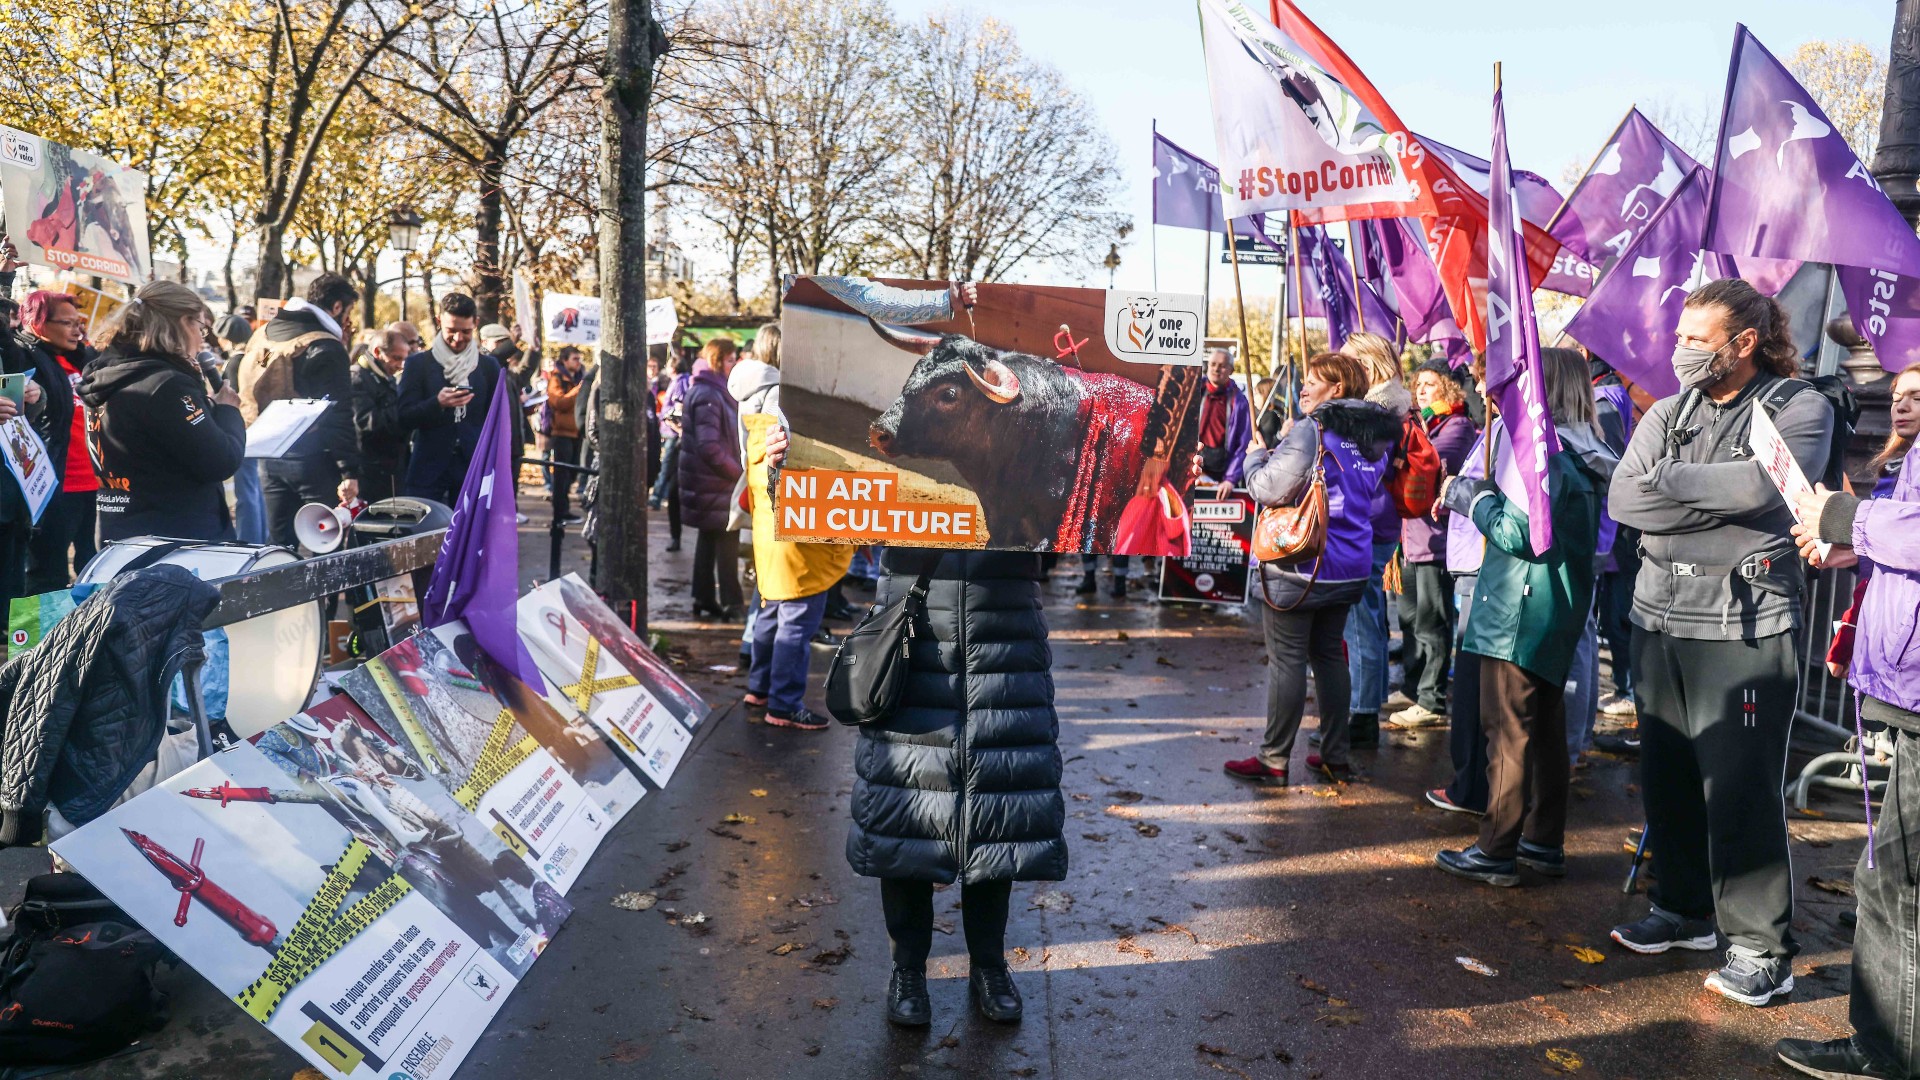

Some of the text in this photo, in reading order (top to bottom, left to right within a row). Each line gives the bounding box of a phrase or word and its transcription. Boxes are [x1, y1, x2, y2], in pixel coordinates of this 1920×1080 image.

[18, 144, 29, 153] one
[19, 153, 34, 163] voice
[47, 249, 128, 276] STOP CORRIDA
[1159, 318, 1183, 330] one
[1158, 332, 1191, 349] voice
[786, 476, 892, 502] NI ART
[784, 506, 971, 535] NI CULTURE
[501, 830, 520, 850] 2
[269, 871, 350, 986] SCENE DE CRIME NE PAS FRANCHIR
[320, 937, 336, 952] DE
[328, 916, 356, 942] CRIME
[346, 913, 364, 927] NE
[357, 902, 377, 920] PAS
[370, 882, 403, 910] FRANCHIR
[409, 950, 422, 965] le
[416, 937, 436, 957] corps
[330, 924, 421, 1016] Une pique montée sur une lance
[399, 958, 417, 979] fois
[355, 993, 384, 1027] perforé
[367, 1000, 406, 1046] provoquant
[398, 995, 412, 1008] de
[406, 973, 432, 1002] grosses
[32, 1018, 74, 1030] Quechua
[350, 1019, 361, 1030] a
[319, 1034, 347, 1060] 1
[400, 1031, 437, 1074] ENSEMBLE
